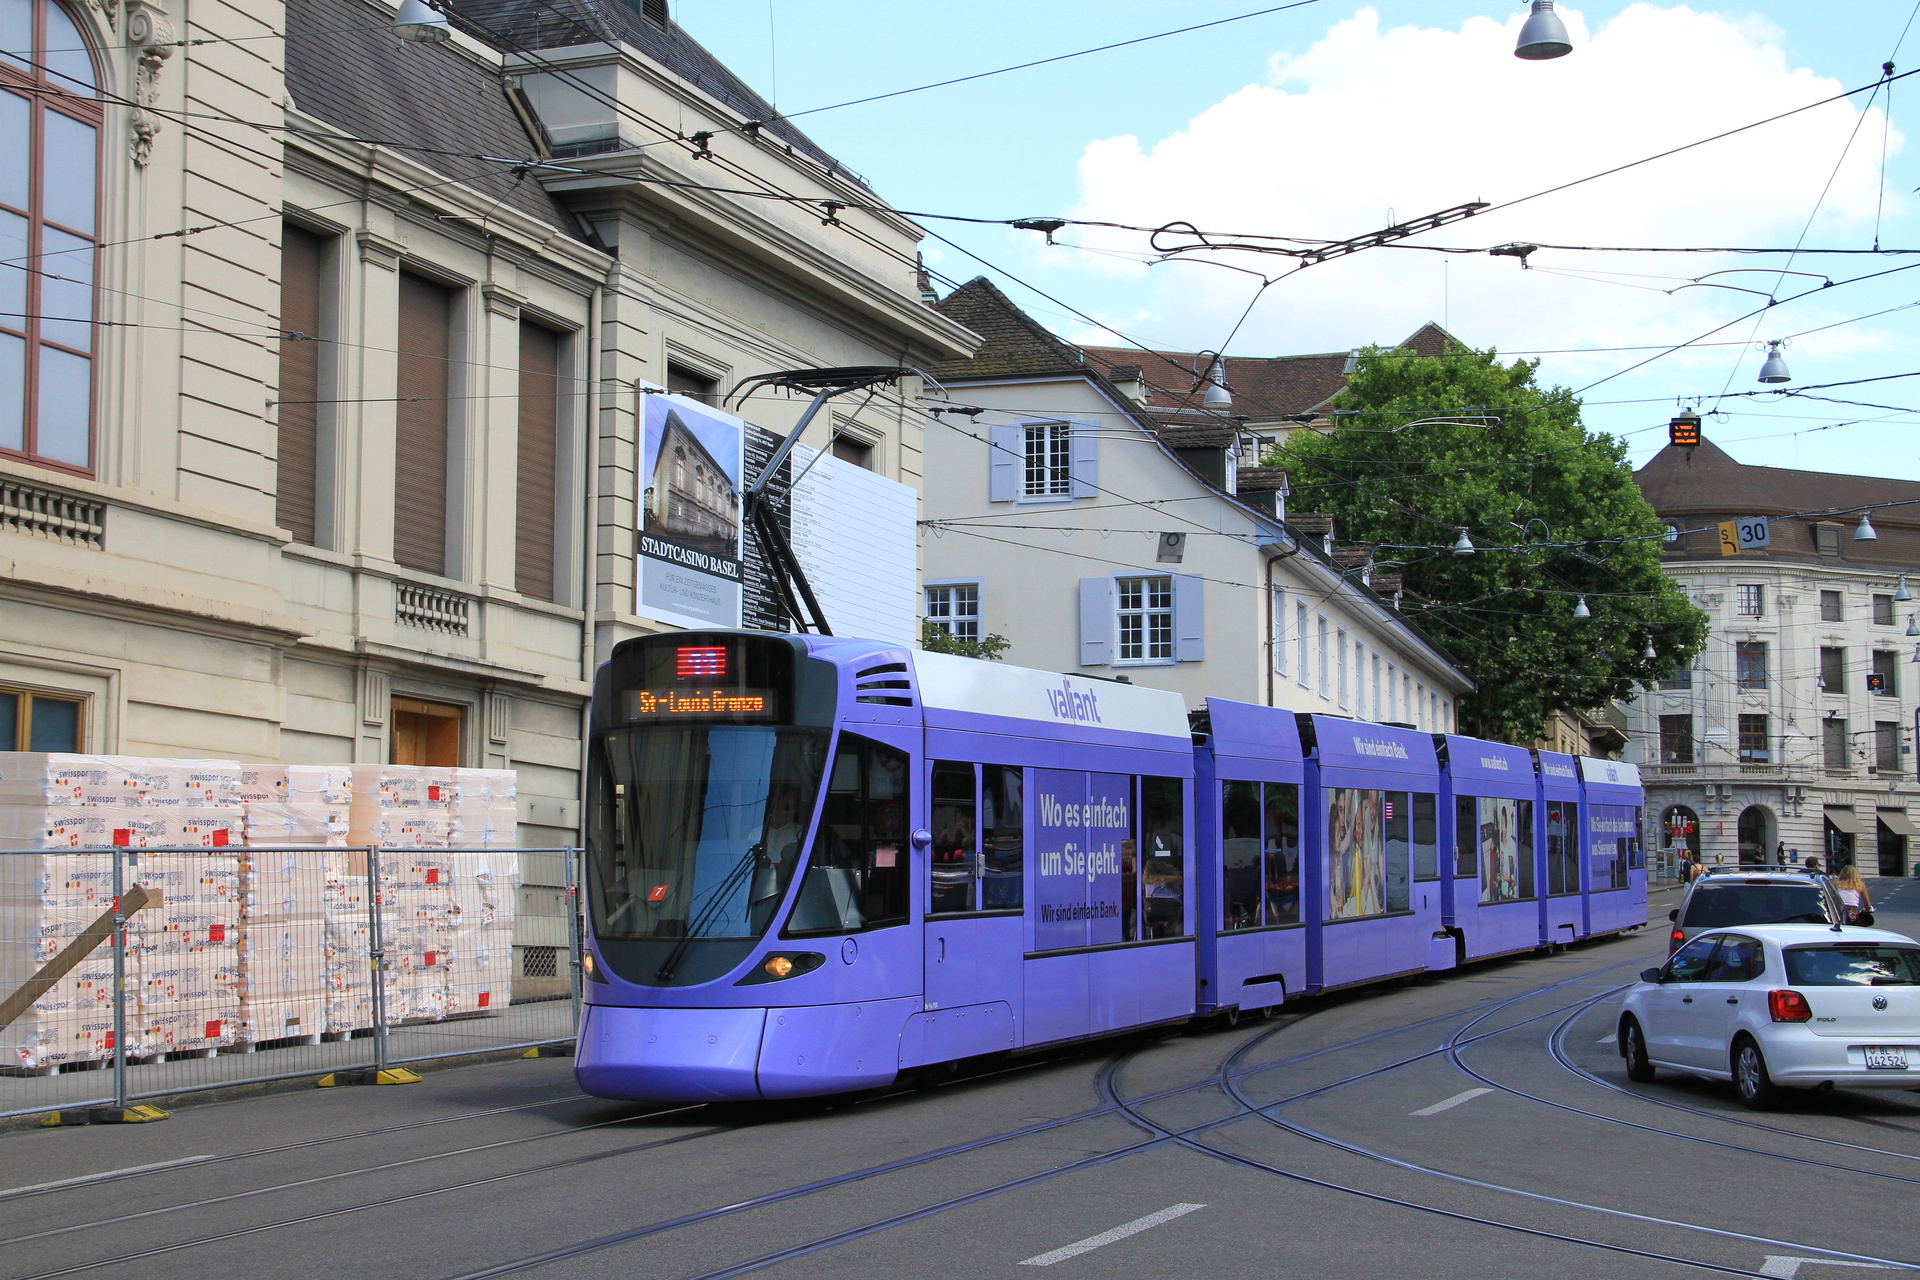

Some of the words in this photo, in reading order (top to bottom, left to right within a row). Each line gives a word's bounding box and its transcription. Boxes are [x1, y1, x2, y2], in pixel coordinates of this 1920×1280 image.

[1741, 523, 1765, 542] 30
[641, 536, 709, 569] STADTCASINO
[710, 557, 739, 578] BASEL
[1046, 679, 1101, 723] valiant
[1352, 736, 1365, 754] Wir
[1364, 738, 1377, 756] sind
[1375, 739, 1395, 757] einfach
[1392, 741, 1409, 759] Bank.
[59, 769, 89, 779] swisspor
[190, 772, 220, 781] swisspor
[87, 794, 117, 803] swisspor
[1040, 794, 1062, 827] Wo
[1065, 803, 1080, 827] es
[1083, 796, 1127, 828] einfach
[54, 817, 86, 827] swisspor
[188, 818, 218, 827] swisspor
[1040, 852, 1062, 876] um
[1064, 843, 1085, 876] Sie
[1088, 843, 1119, 883] geht.
[71, 871, 102, 880] swisspor
[1041, 904, 1055, 923] Wir
[1056, 903, 1071, 922] sind
[1072, 901, 1099, 920] einfach
[1100, 900, 1119, 918] Bank.
[82, 1022, 113, 1031] swisspor
[1880, 1047, 1890, 1055] BL
